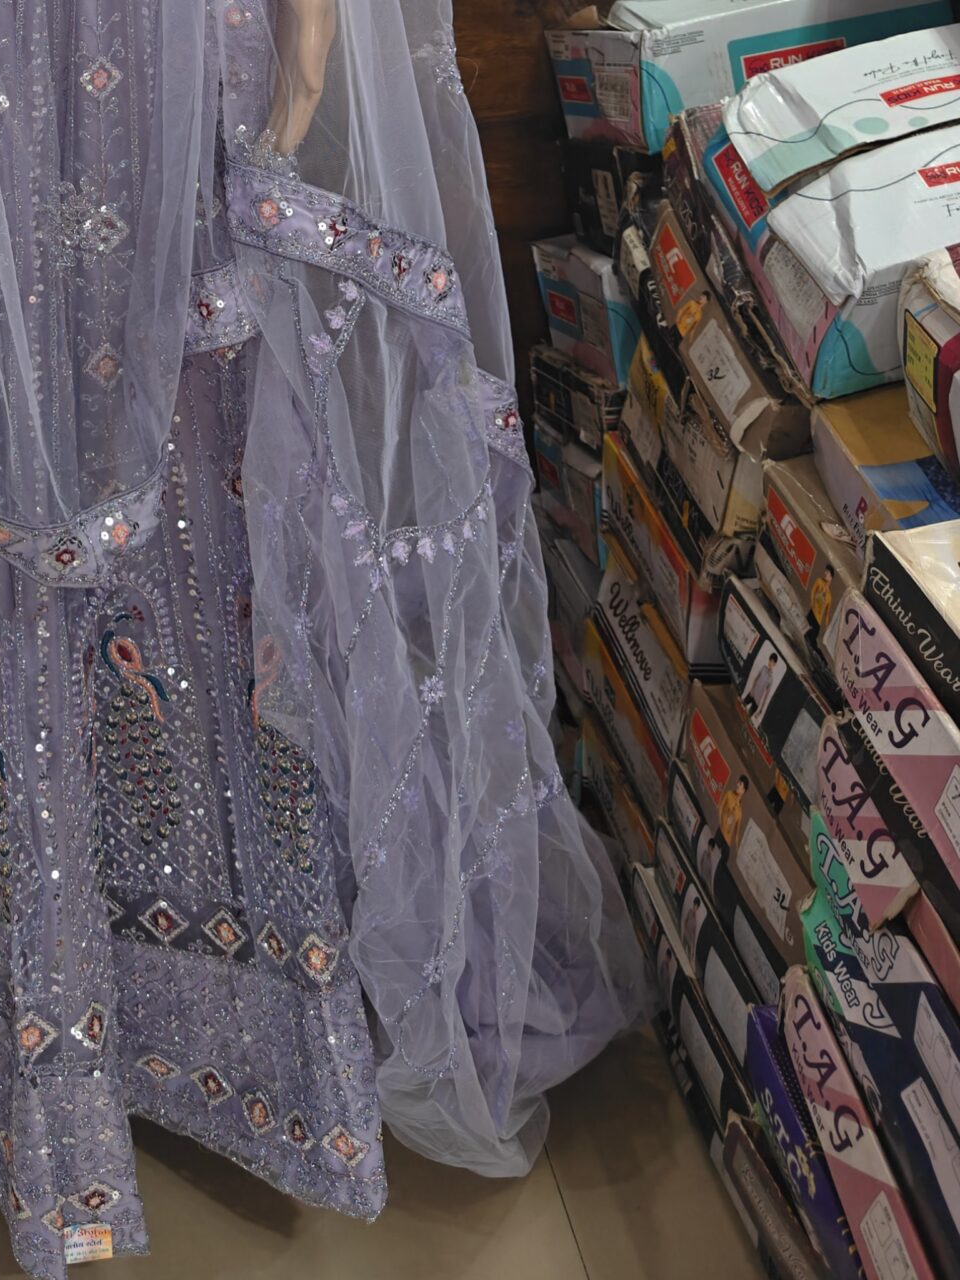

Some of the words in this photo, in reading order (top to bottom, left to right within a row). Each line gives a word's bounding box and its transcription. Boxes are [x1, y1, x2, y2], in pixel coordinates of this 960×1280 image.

[769, 52, 803, 70] RUN
[888, 90, 920, 103] KIDS
[923, 80, 955, 94] RUN
[730, 160, 750, 190] RUN
[609, 582, 652, 682] Wellmove
[870, 567, 917, 635] Ethinic
[917, 628, 960, 692] Wear
[840, 662, 859, 699] Kids
[858, 695, 883, 738] Wear
[842, 608, 932, 750] T.A.G
[821, 736, 902, 880] T.A.G
[834, 823, 856, 866] Wear
[814, 919, 837, 963] Kids
[832, 960, 861, 1009] Wear
[792, 994, 864, 1154] T.A.G
